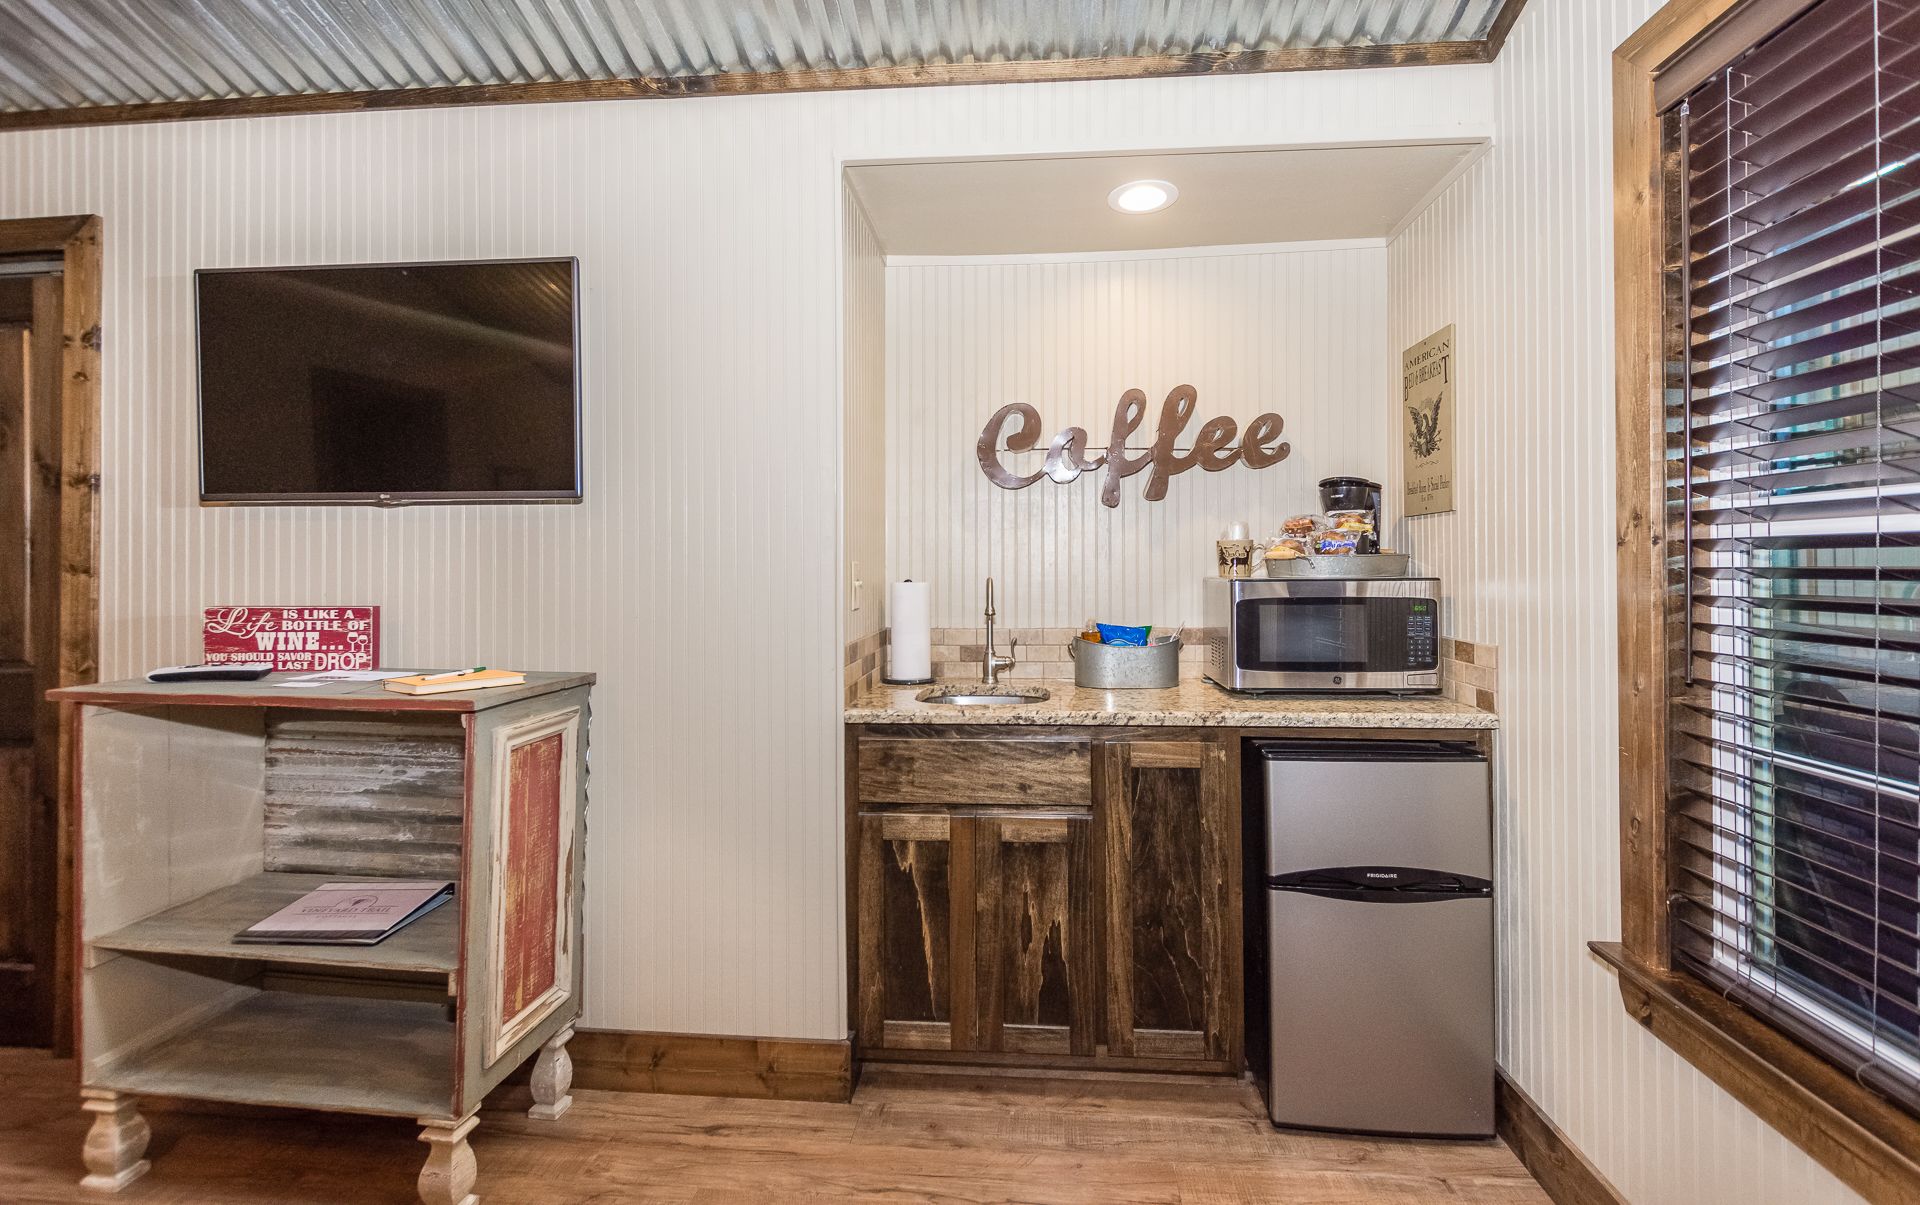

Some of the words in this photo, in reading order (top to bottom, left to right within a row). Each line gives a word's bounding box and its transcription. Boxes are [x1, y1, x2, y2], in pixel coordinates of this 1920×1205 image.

[1404, 339, 1450, 371] AMERICAN
[1419, 354, 1450, 384] BREAKFAST
[976, 384, 1291, 509] Coffee
[207, 607, 279, 639] Life
[283, 609, 299, 619] IS
[304, 609, 340, 619] LIKE
[344, 609, 355, 619] A
[282, 620, 342, 631] BOTTLE
[347, 620, 369, 630] OF
[255, 632, 344, 650] WINE...
[206, 652, 229, 661] YOU
[231, 652, 274, 661] SHOULD
[277, 652, 312, 661] SAVOR
[277, 661, 311, 670] LAST
[314, 652, 368, 671] DROP
